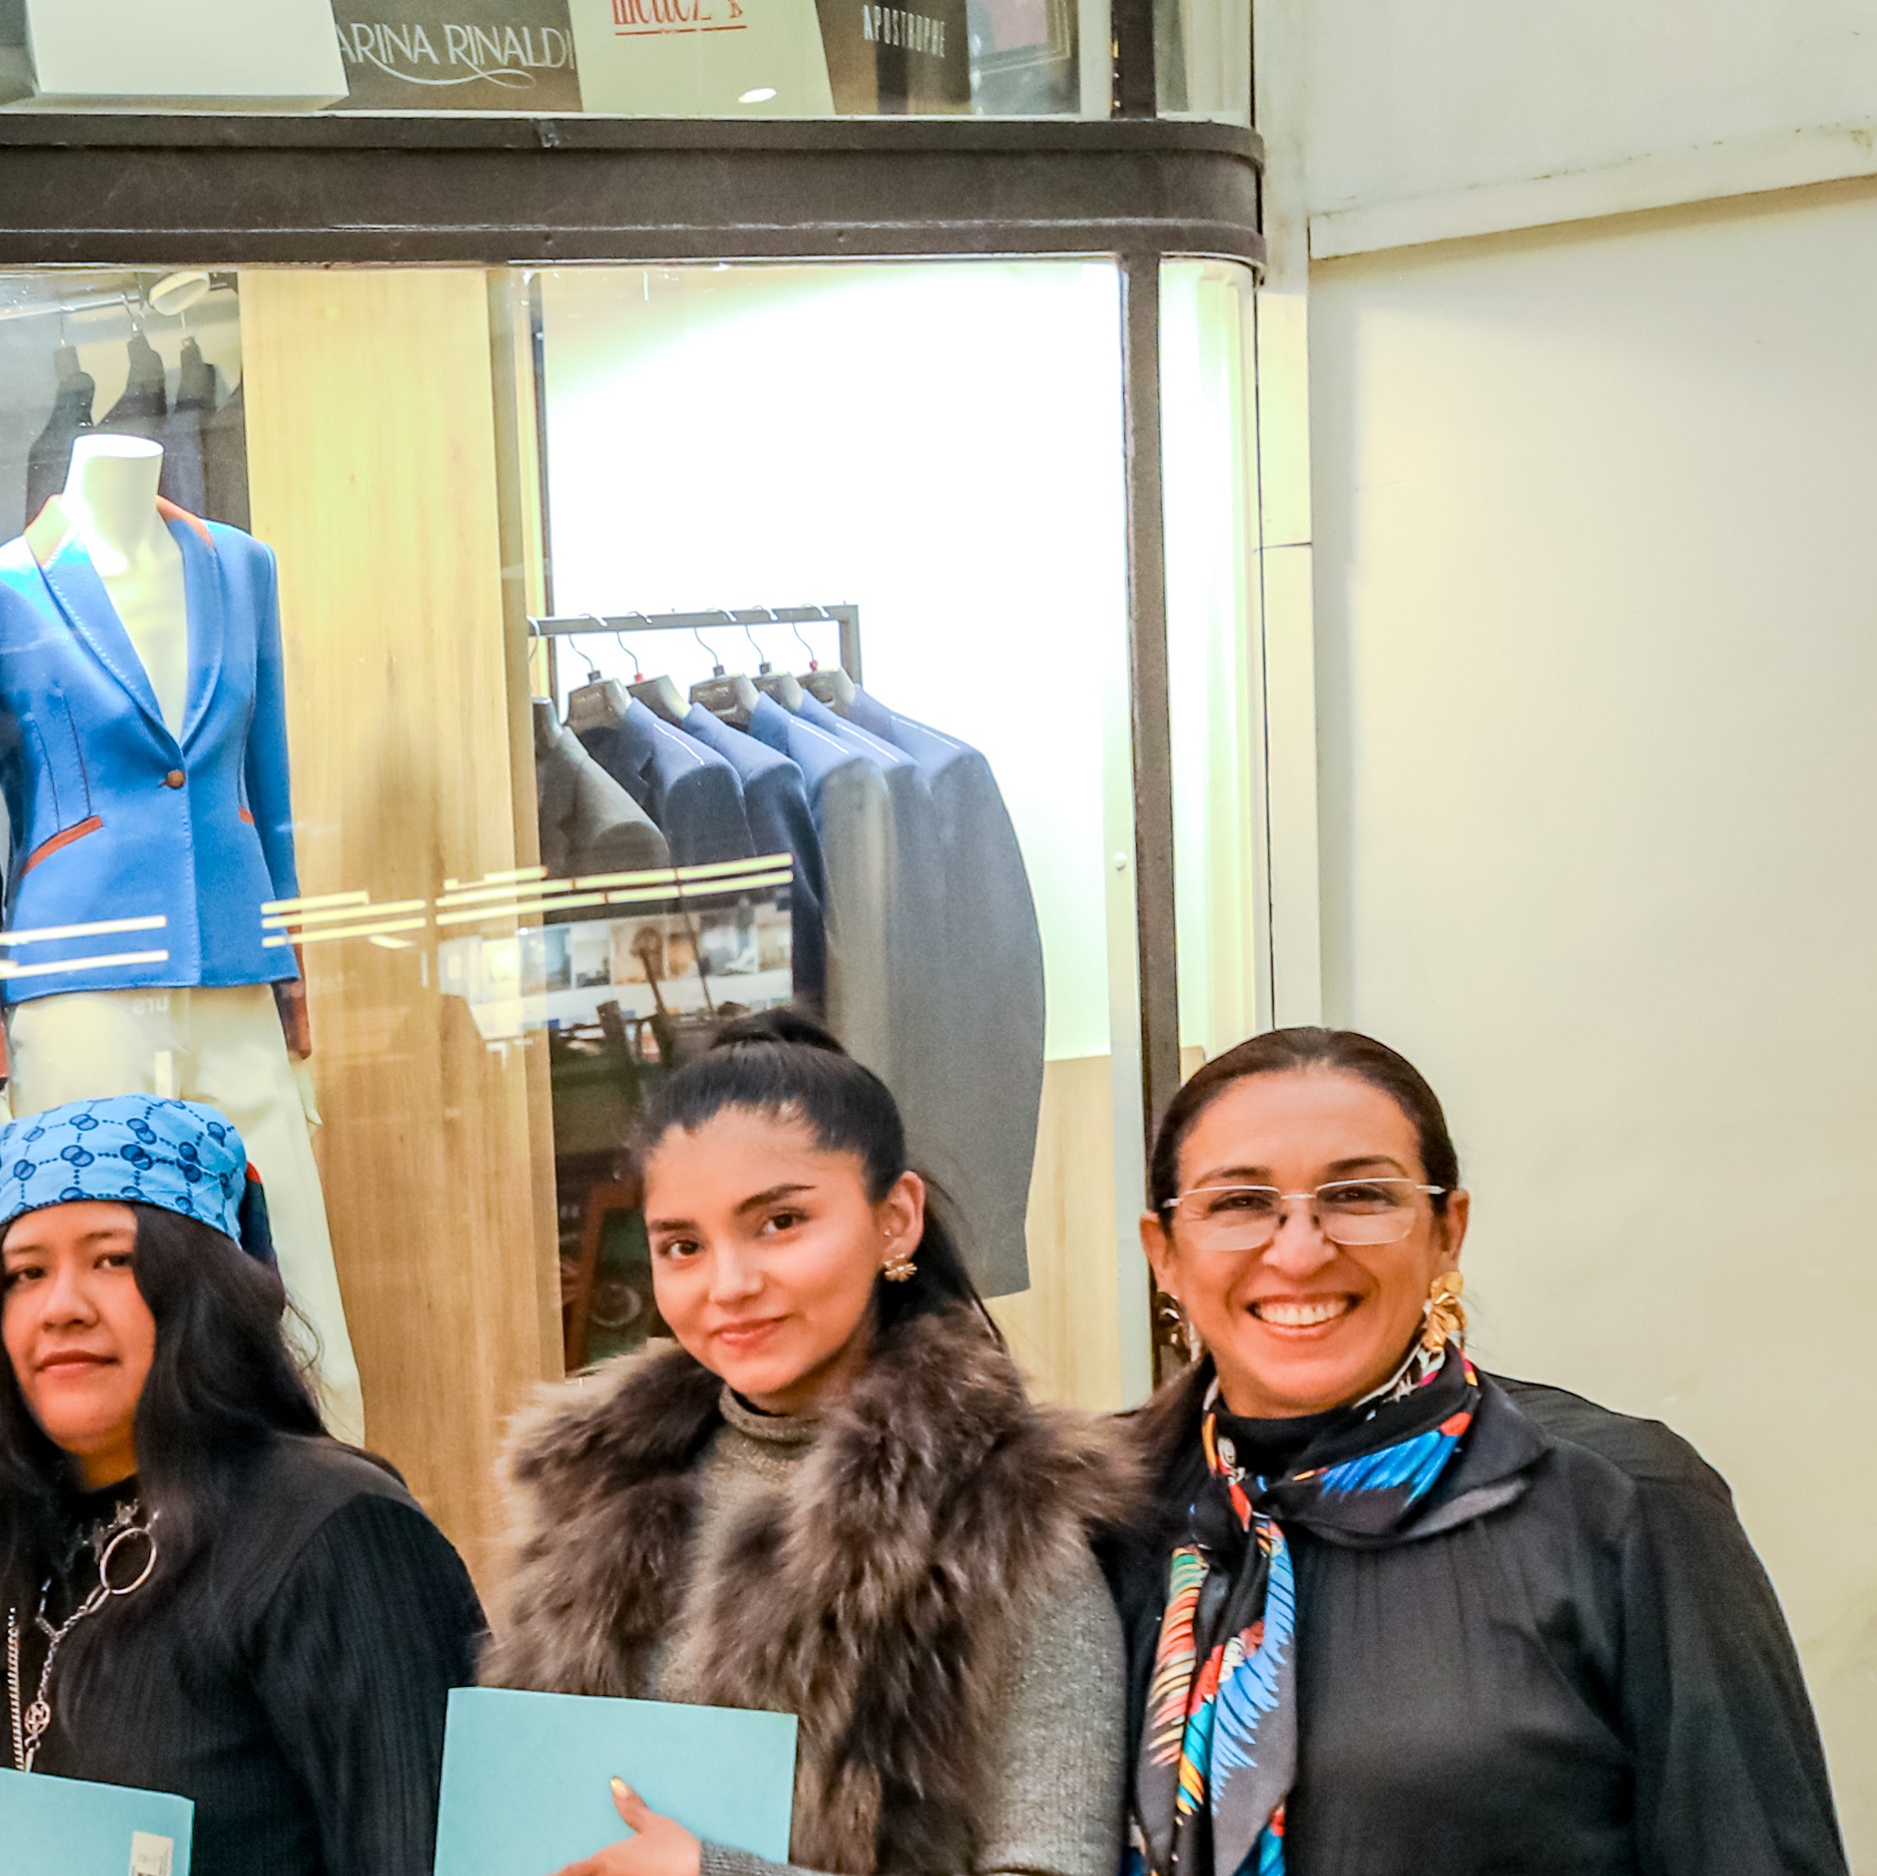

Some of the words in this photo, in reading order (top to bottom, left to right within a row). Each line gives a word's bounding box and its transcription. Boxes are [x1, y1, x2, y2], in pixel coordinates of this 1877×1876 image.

[335, 22, 440, 74] ARINA
[442, 23, 576, 76] RINALDI
[862, 4, 946, 58] APOSTROPHE
